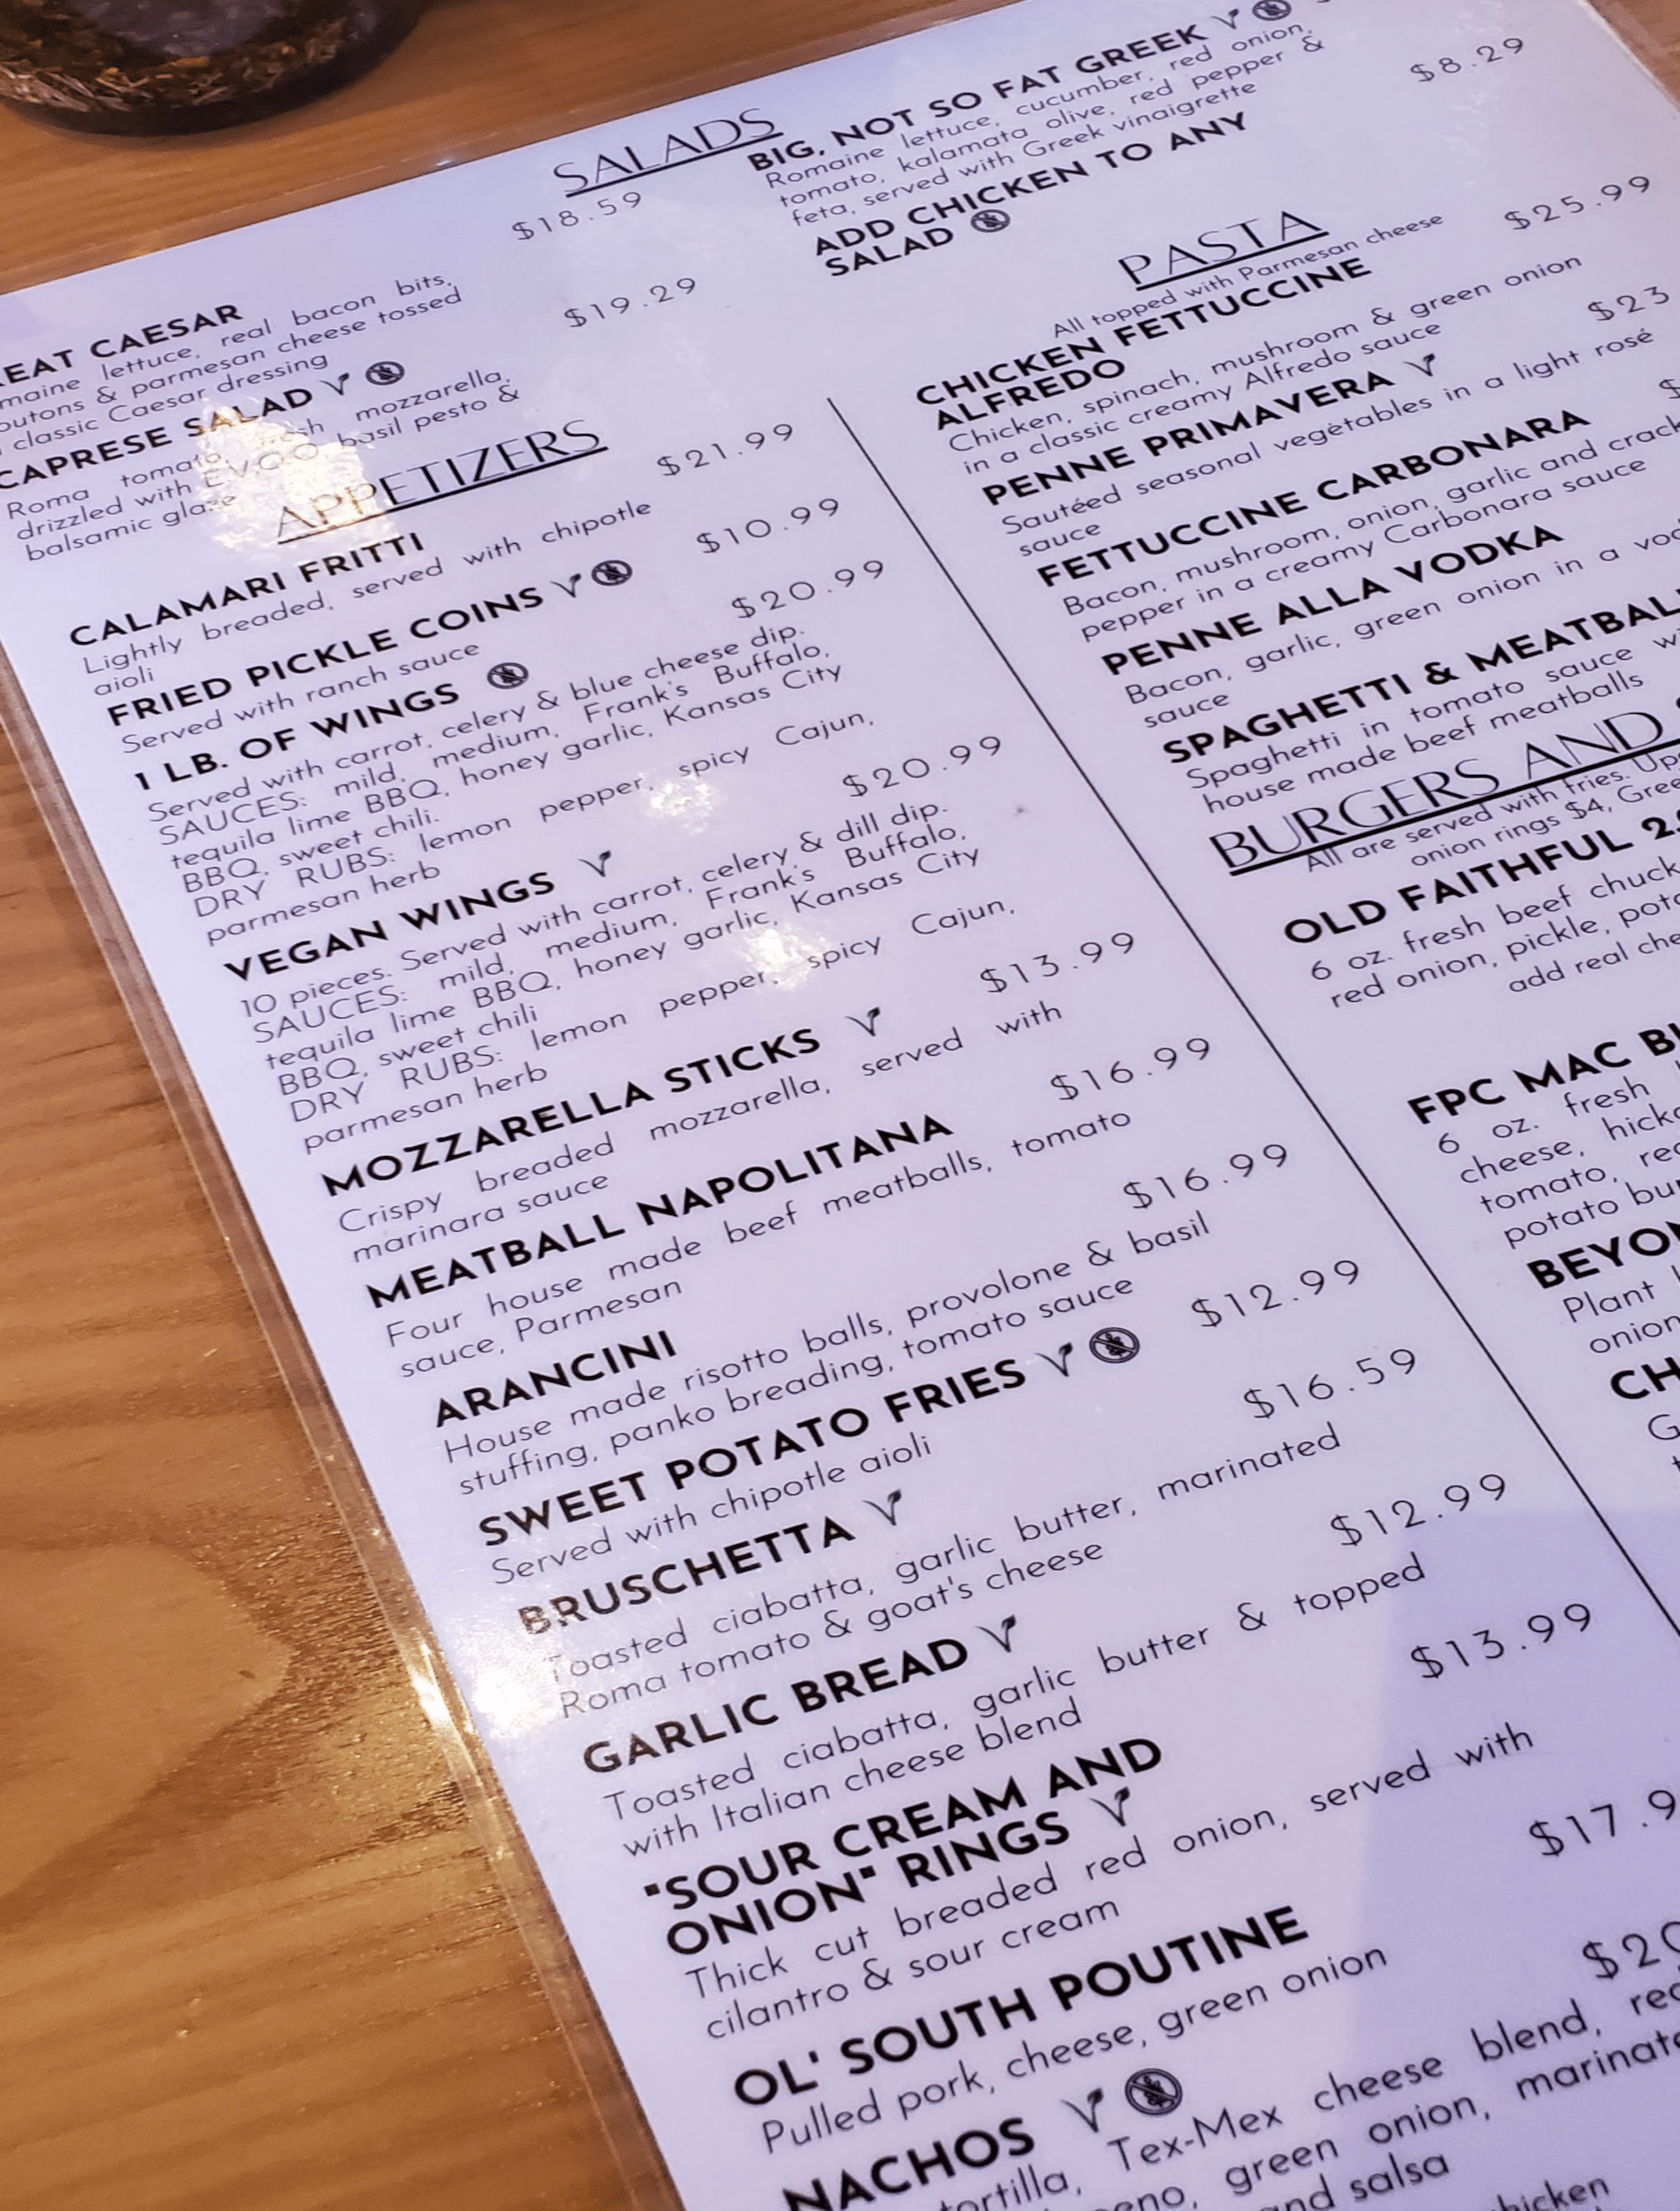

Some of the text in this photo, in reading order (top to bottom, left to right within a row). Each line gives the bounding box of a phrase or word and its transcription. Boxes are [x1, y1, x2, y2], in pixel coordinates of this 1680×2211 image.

[745, 23, 1210, 172] BIG, NOT SO FAT GREEK
[1409, 37, 1524, 82] $8.29
[554, 106, 777, 195] SALADS
[957, 82, 1257, 177] with Greek vinaigrette
[511, 191, 642, 241] $18.59
[815, 110, 1247, 256] ADD CHICKEN TO ANY
[1503, 175, 1651, 230] $25.99
[824, 226, 954, 277] SALAD
[1053, 215, 1444, 339] All topped with Parmesan cheese
[1118, 210, 1321, 287] PASTA
[0, 303, 245, 387] EAT CAESAR
[130, 285, 462, 399] parmesan cheese tossed
[220, 295, 377, 348] real bacon
[563, 277, 696, 328] $19.29
[915, 256, 1373, 405] CHICKEN FETTUCCINE
[0, 387, 313, 490] CAPRESE SALAD
[12, 354, 328, 450] classic Caesar dressing
[936, 358, 1126, 431] ALFREDO
[962, 323, 1441, 475] in a classic creamy Alfredo sauce
[981, 370, 1397, 506] PENNE PRIMAVERA
[276, 419, 602, 539] APPETIZERS
[656, 423, 793, 477] $21.99
[1035, 409, 1592, 588] FETTUCCINE CARBONARA
[695, 497, 839, 554] $10.99
[68, 531, 425, 646] CALAMARI FRITTI
[82, 499, 652, 674] Lightly served with chipotle
[730, 559, 884, 619] $20.99
[1100, 524, 1566, 676] PENNE ALLA VODKA
[93, 664, 155, 696] aioli
[105, 585, 544, 727] FRIED PICKLE COINS
[121, 644, 479, 754] Served with ranch sauce
[133, 682, 460, 791] 1 LB. OF WINGS
[1162, 661, 1462, 764] SPAGHETTI &
[1202, 669, 1645, 814] house made beef meatballs
[170, 664, 842, 869] tequila lime honey Kansas City
[841, 735, 1002, 798] $20.99
[1209, 711, 1664, 868] BURGERS AND
[222, 870, 555, 982] VEGAN WINGS
[1283, 829, 1635, 944] OLD FAITHFUL
[1402, 883, 1572, 953] fresh beef
[979, 931, 1134, 993] $13.99
[303, 1060, 547, 1155] parmesan herb
[319, 1028, 821, 1197] MOZZARELLA STICKS
[338, 999, 1063, 1232] Crispy breaded served with
[1050, 1037, 1210, 1101] $16.99
[1406, 1040, 1633, 1125] FPC MAC
[364, 1113, 955, 1309] MEATBALL NAPOLITANA
[1122, 1143, 1288, 1210] $16.99
[386, 1112, 1132, 1348] Four house made beef tomato
[443, 1209, 1210, 1464] House made risotto provolone & basil
[1190, 1259, 1360, 1327] $12.99
[435, 1329, 677, 1428] ARANCINI
[1242, 1348, 1416, 1419] $16.59
[477, 1358, 1027, 1547] SWEET POTATO FRIES
[491, 1430, 932, 1585] Served with chipotle aioli
[1330, 1473, 1506, 1547] $12.99
[516, 1514, 857, 1635] BRUSCHETTA
[602, 1550, 1426, 1820] Toasted garlic butter topped
[1409, 1603, 1592, 1679] $13.99
[582, 1637, 969, 1774] GARLIC BREAD
[832, 1774, 1028, 1858] CREAM
[1049, 1737, 1162, 1799] AND
[895, 1809, 1070, 1888] RINGS
[733, 1904, 1310, 2108] OL' SOUTH POUTINE
[781, 2115, 1035, 2211] NACHOS
[1106, 2056, 1444, 2172] Tex-Mex cheese
[1348, 2151, 1450, 2204] salsa
